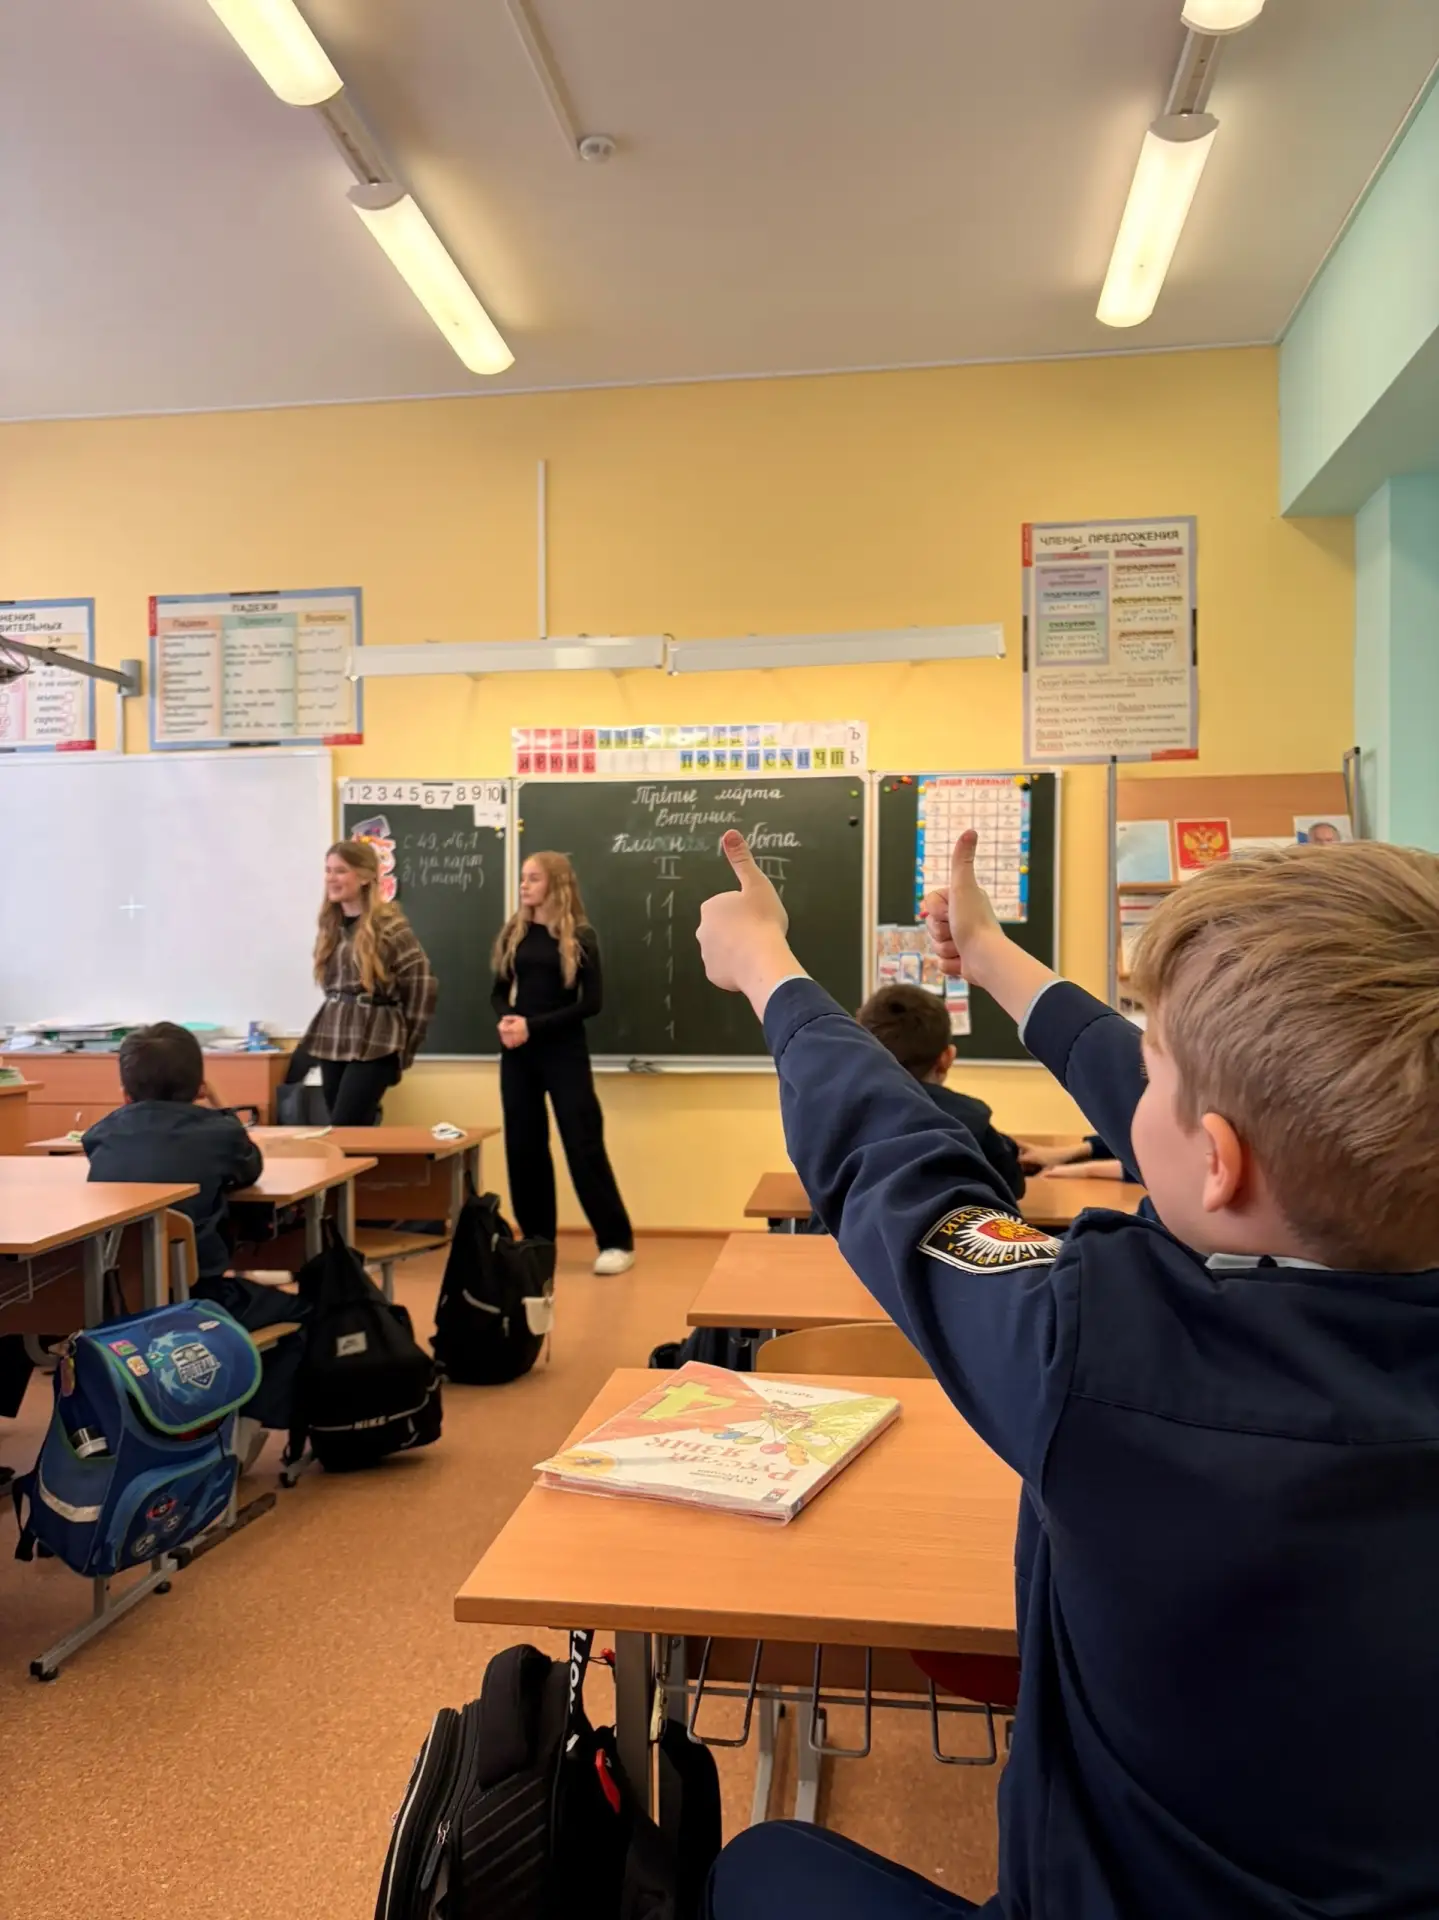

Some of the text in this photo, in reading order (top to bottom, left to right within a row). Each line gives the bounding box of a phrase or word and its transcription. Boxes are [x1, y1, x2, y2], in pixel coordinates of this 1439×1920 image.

[1040, 530, 1179, 546] ЧЛЕНЫ ПРЕДЛОЖЕНИЯ
[231, 602, 278, 613] ПАДЕЖИ
[362, 786, 372, 800] 2
[378, 786, 388, 801] 3
[393, 786, 403, 800] 4
[409, 787, 420, 801] 5
[425, 790, 435, 804] 6
[440, 790, 450, 804] 7
[456, 787, 466, 801] 8
[471, 786, 482, 800] 9
[487, 786, 500, 801] 10
[639, 1382, 736, 1421] 4
[353, 1415, 387, 1430] NIKE
